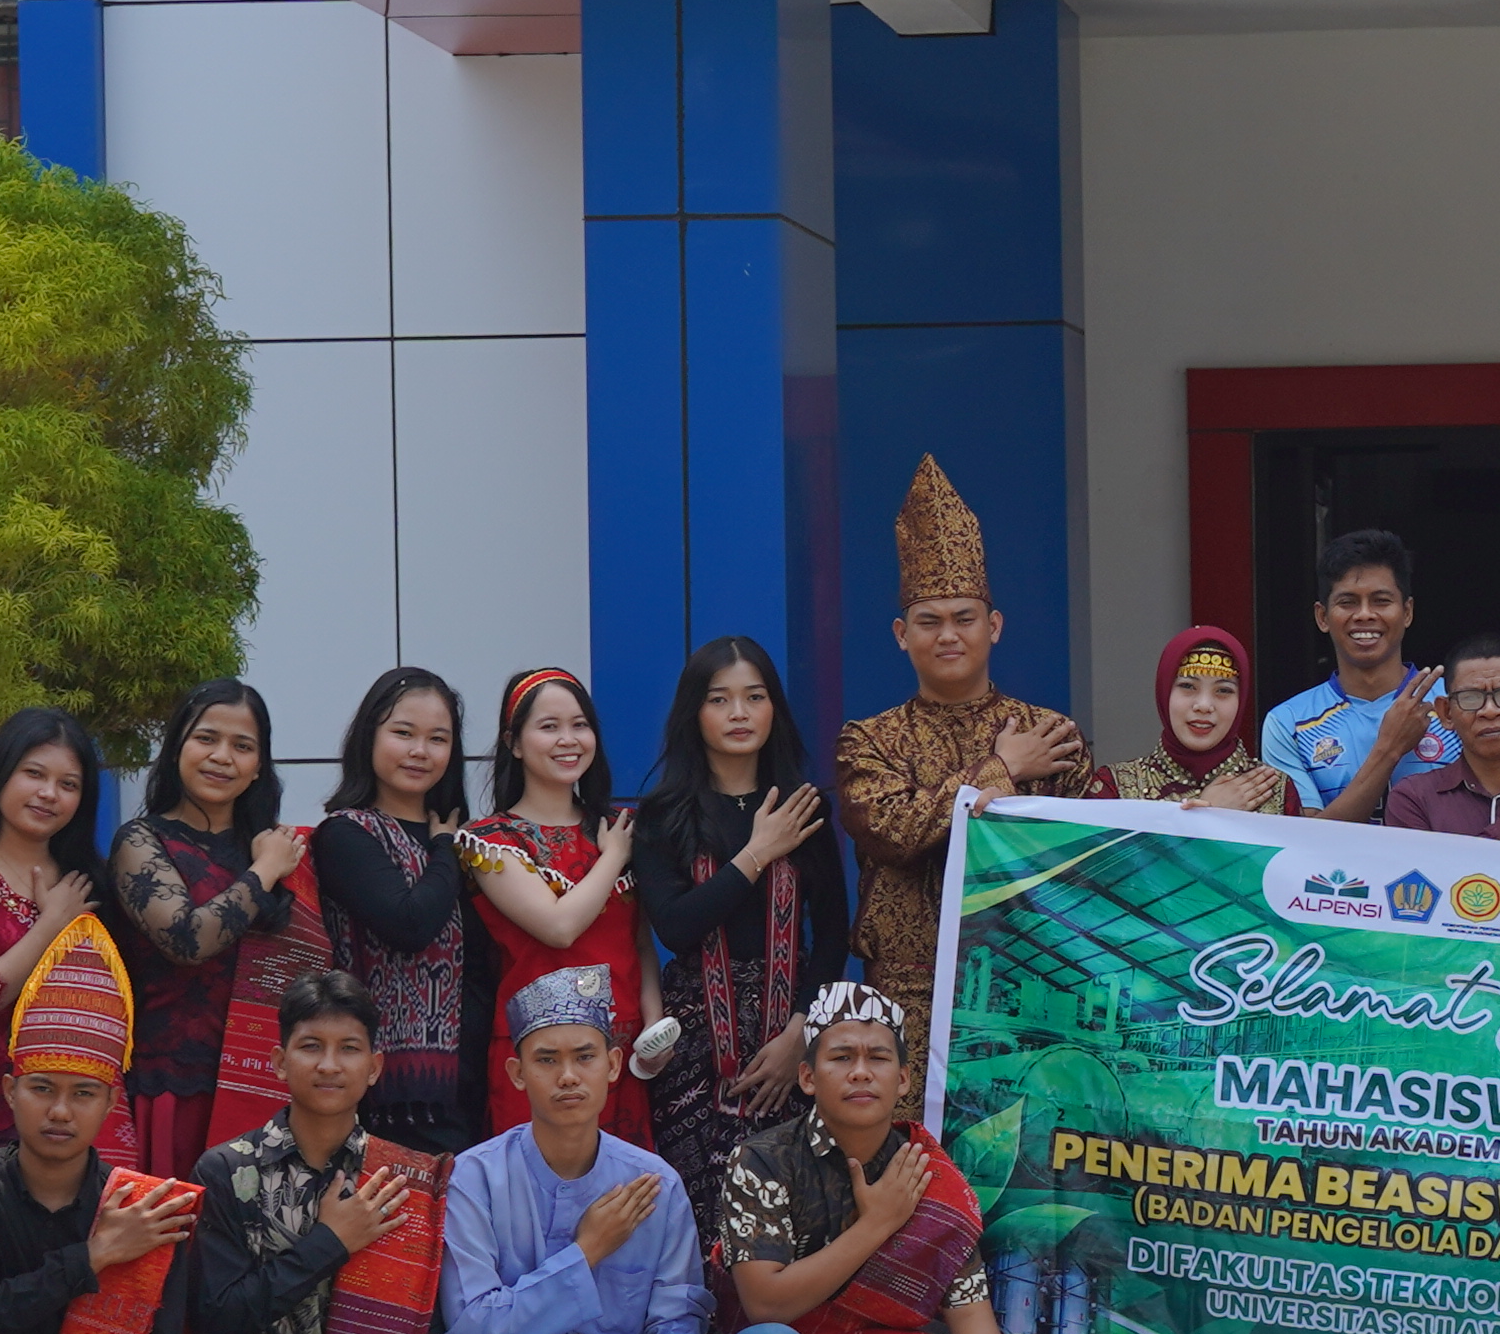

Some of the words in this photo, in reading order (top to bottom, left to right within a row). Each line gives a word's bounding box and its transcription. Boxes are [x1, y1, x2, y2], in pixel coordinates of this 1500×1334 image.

[1287, 896, 1383, 919] ALPENSI
[1184, 935, 1500, 1030] Selamat
[1259, 1119, 1362, 1149] TAHUN
[1052, 1133, 1306, 1202] PENERIMA
[1134, 1188, 1262, 1234] (BADAN
[1270, 1210, 1461, 1255] PENGELOLA
[1130, 1240, 1166, 1273] DI
[1172, 1247, 1362, 1299] FAKULTAS
